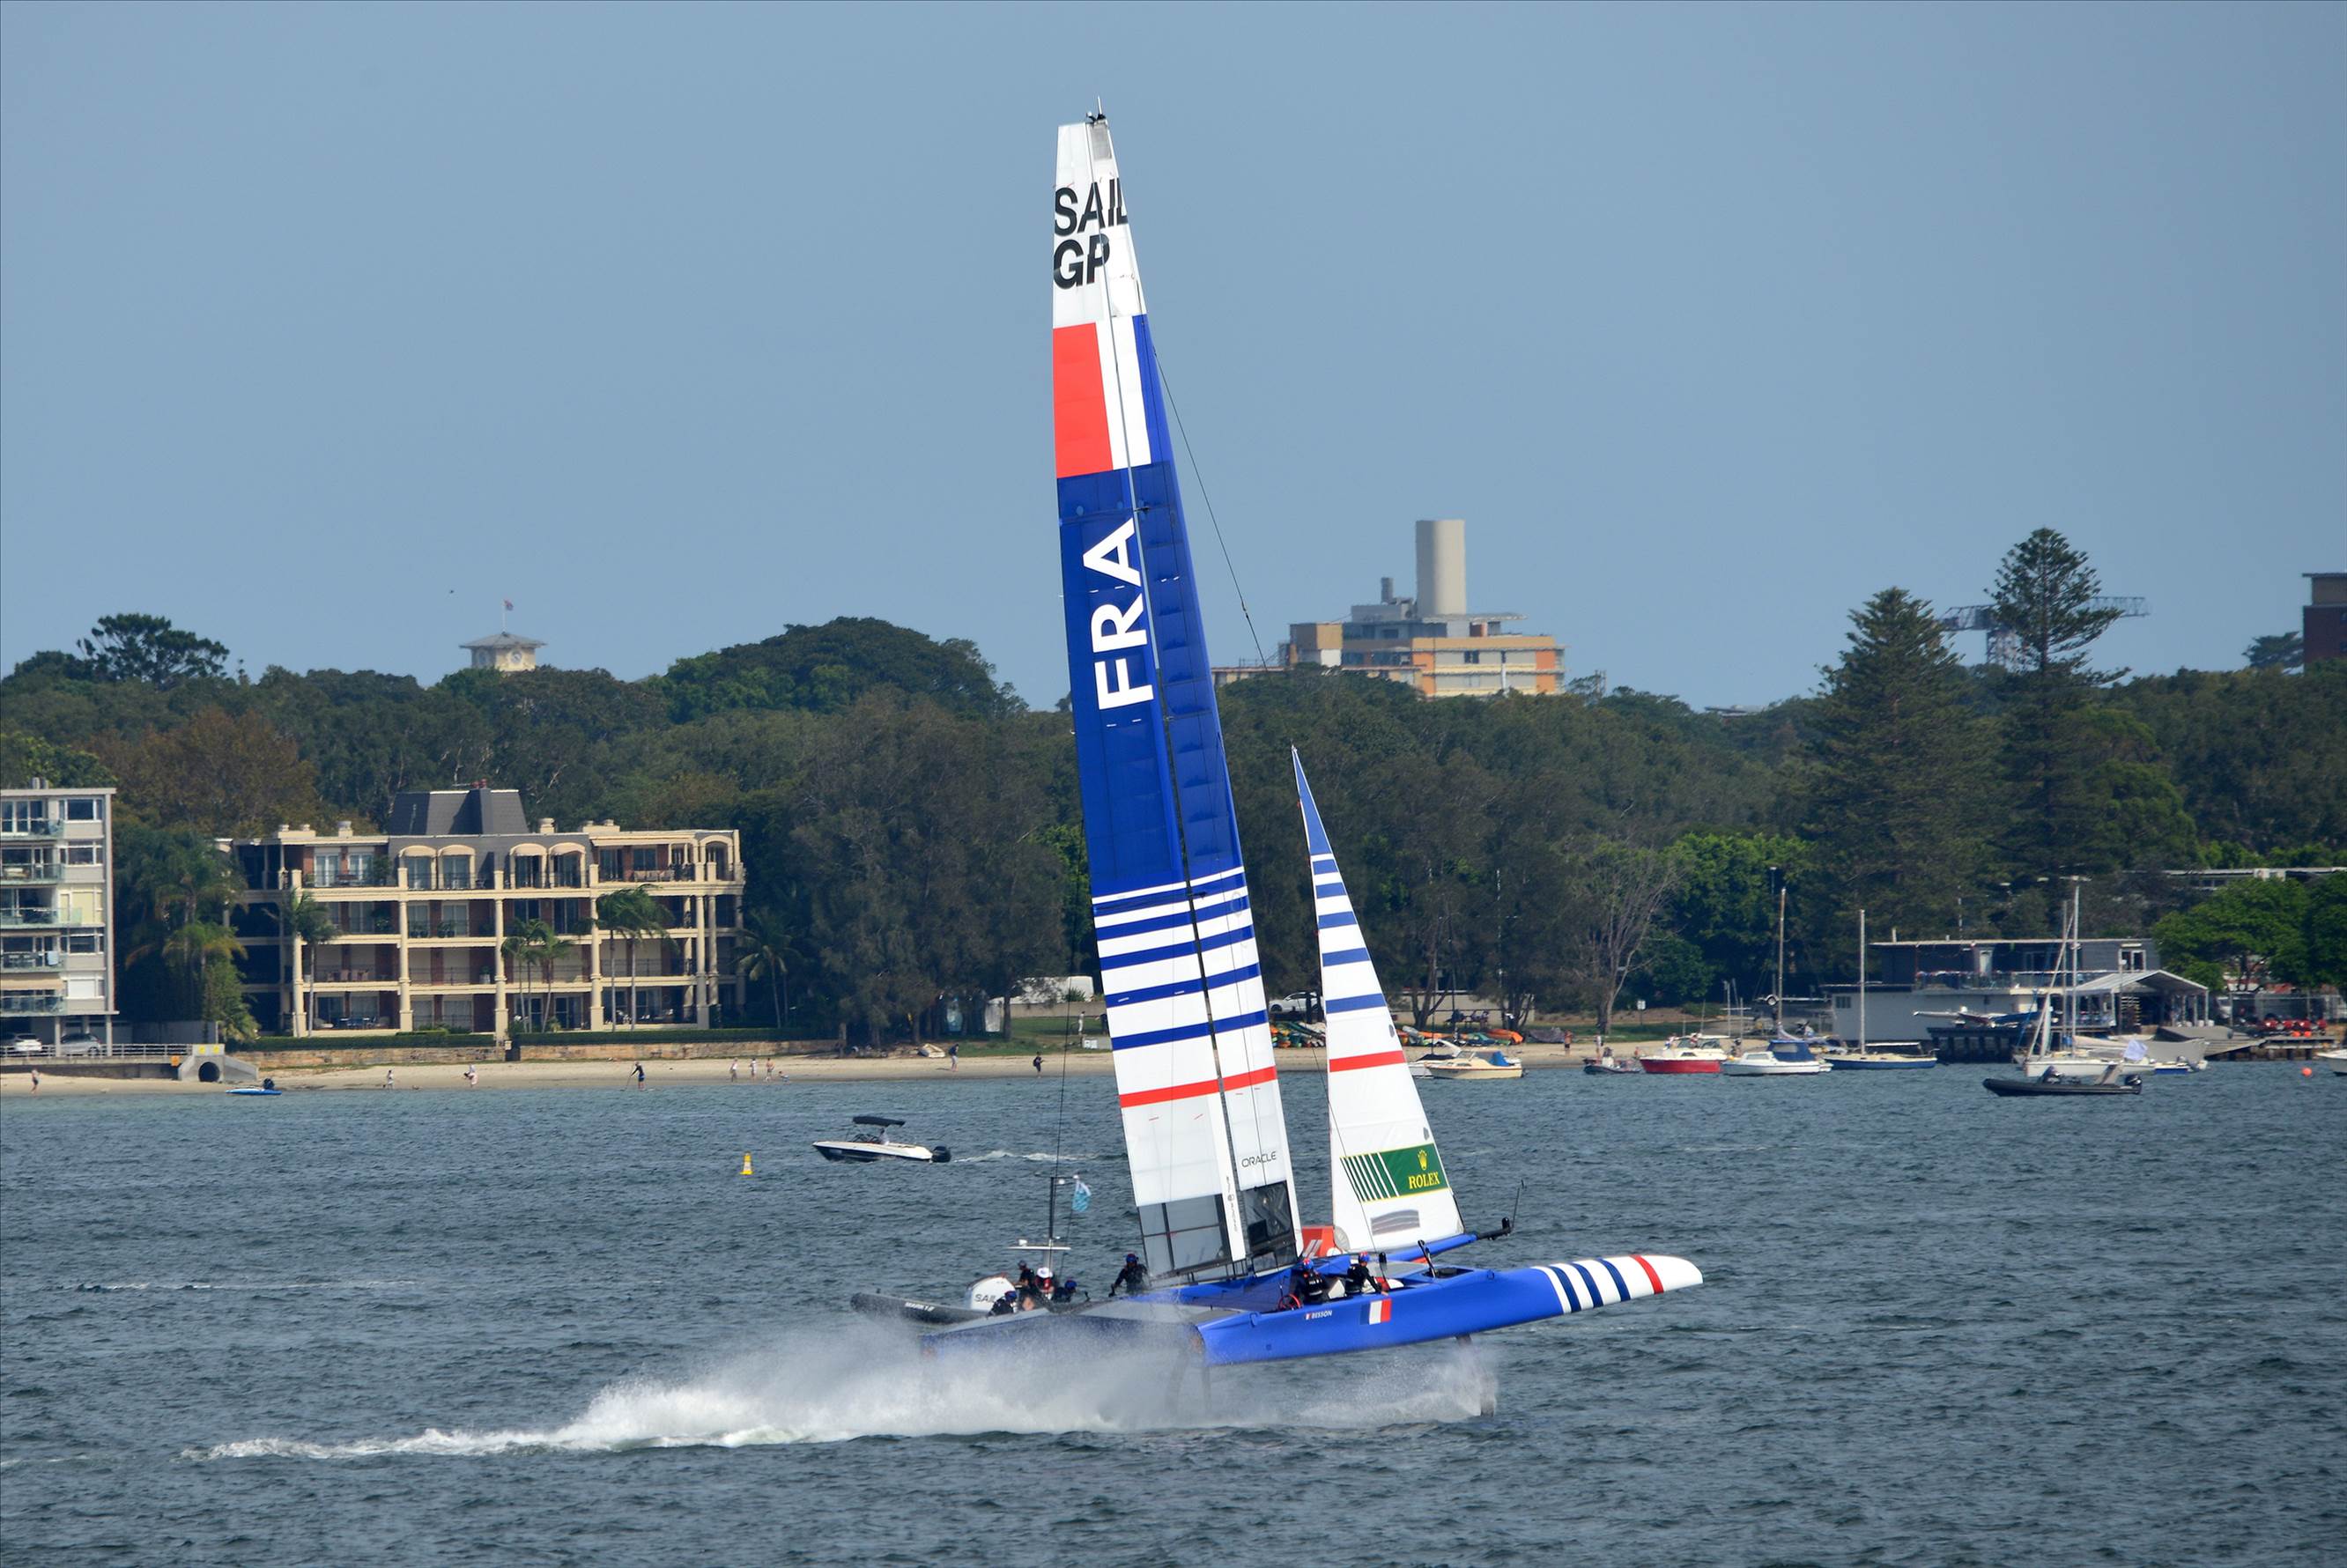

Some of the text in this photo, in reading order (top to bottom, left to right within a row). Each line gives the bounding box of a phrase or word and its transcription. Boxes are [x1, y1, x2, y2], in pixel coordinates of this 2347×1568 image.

[1055, 178, 1129, 236] SAIL
[1054, 233, 1110, 289] GP
[1083, 518, 1153, 710] FRA
[1241, 1150, 1277, 1167] ORACLE
[1408, 1172, 1440, 1189] ROLEX
